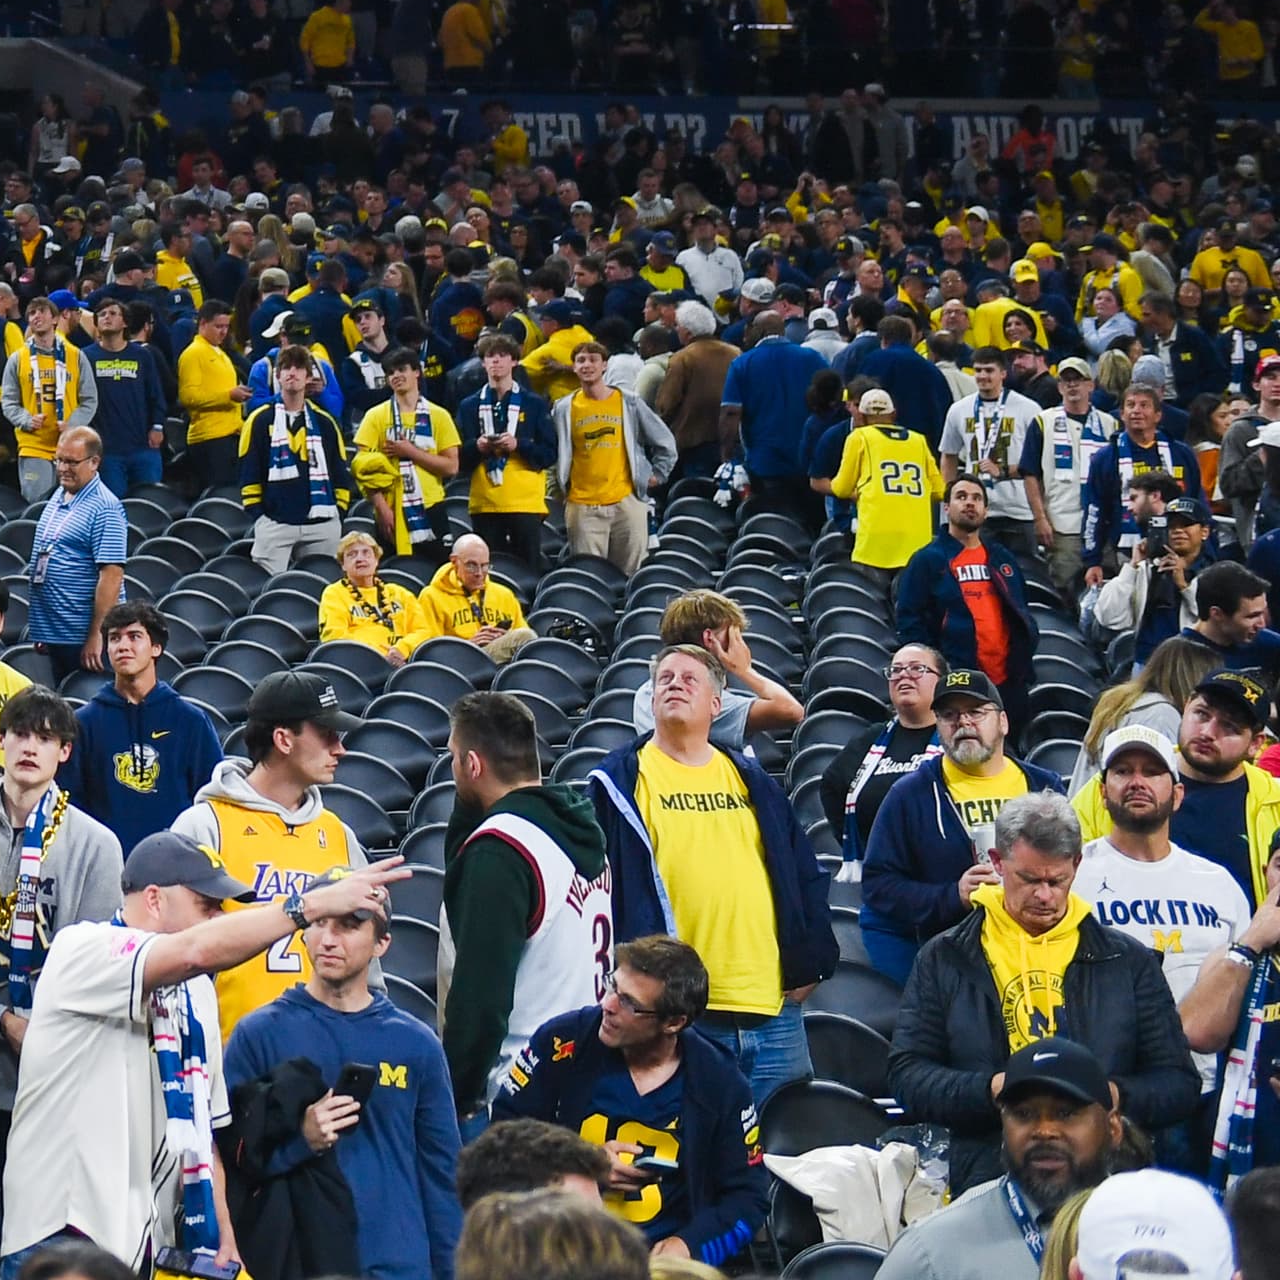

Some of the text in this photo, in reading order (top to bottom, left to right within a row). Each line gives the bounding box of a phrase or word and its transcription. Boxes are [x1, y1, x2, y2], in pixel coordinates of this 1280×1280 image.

[880, 461, 923, 498] 23
[945, 671, 971, 687] M
[659, 793, 748, 812] MICHIGAN
[254, 863, 315, 902] LAKE
[1097, 899, 1222, 929] LOCK IT IN.
[1151, 928, 1185, 954] M
[592, 912, 613, 1004] 3
[377, 1061, 408, 1090] M
